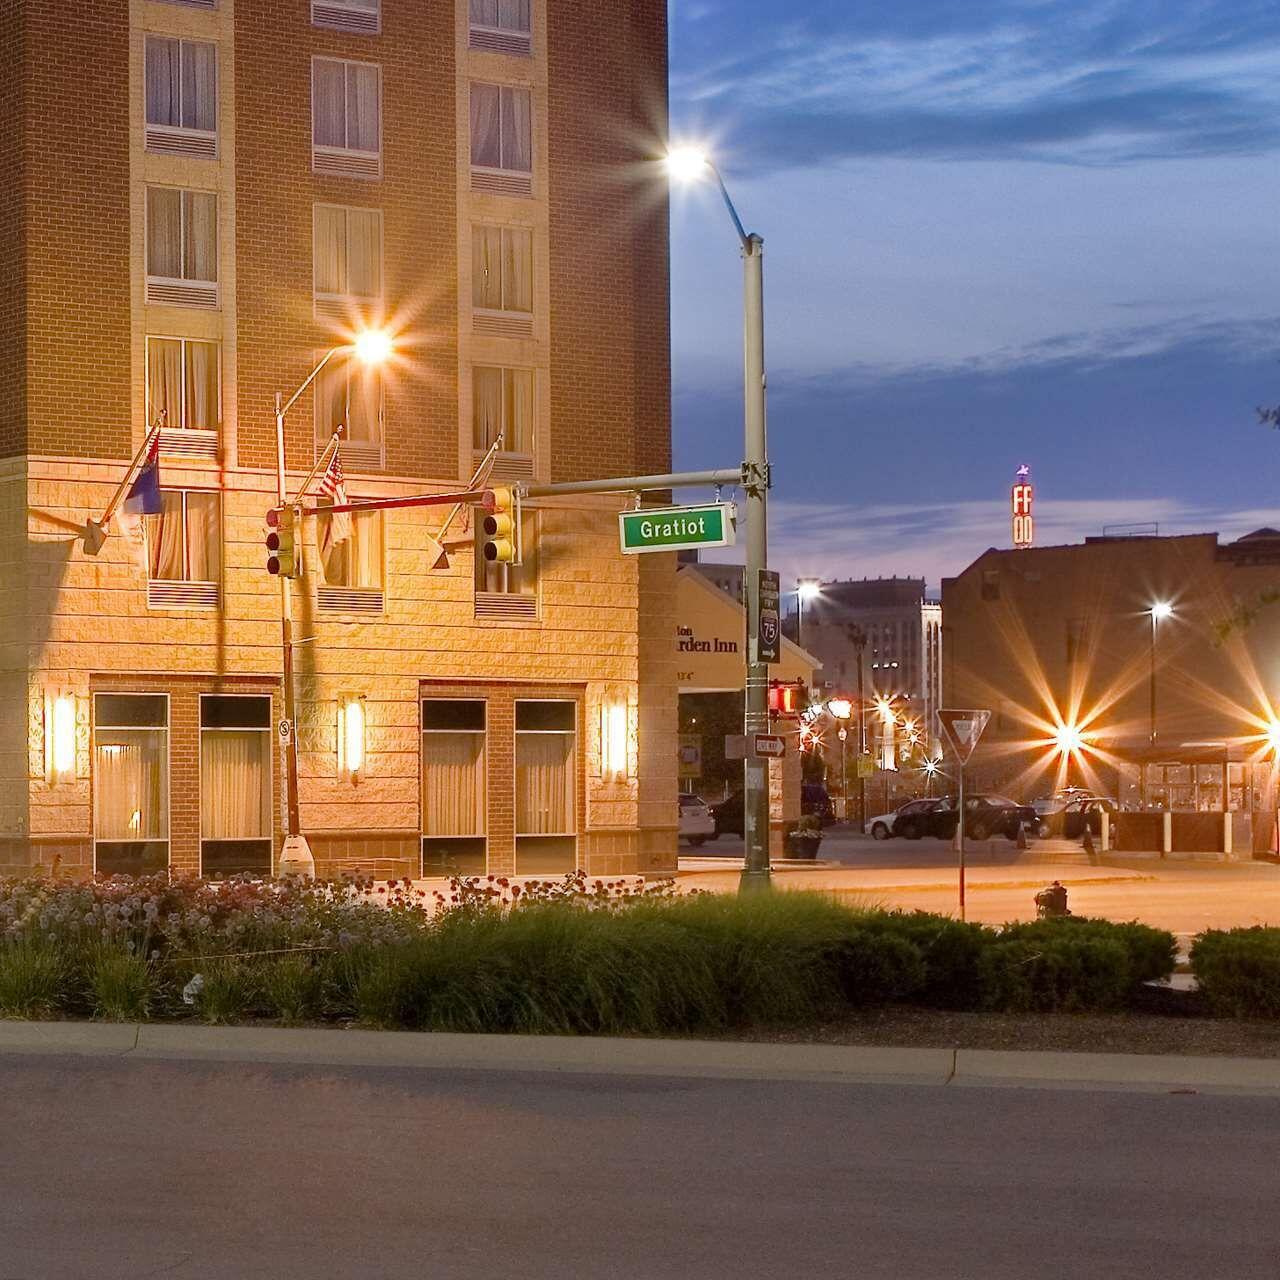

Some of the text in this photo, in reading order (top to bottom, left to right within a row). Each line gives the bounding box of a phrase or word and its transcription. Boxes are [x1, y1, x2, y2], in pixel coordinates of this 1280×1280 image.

[640, 517, 705, 538] Gratiot
[677, 625, 693, 636] ton
[764, 623, 775, 638] 75
[678, 637, 738, 653] rden Inn
